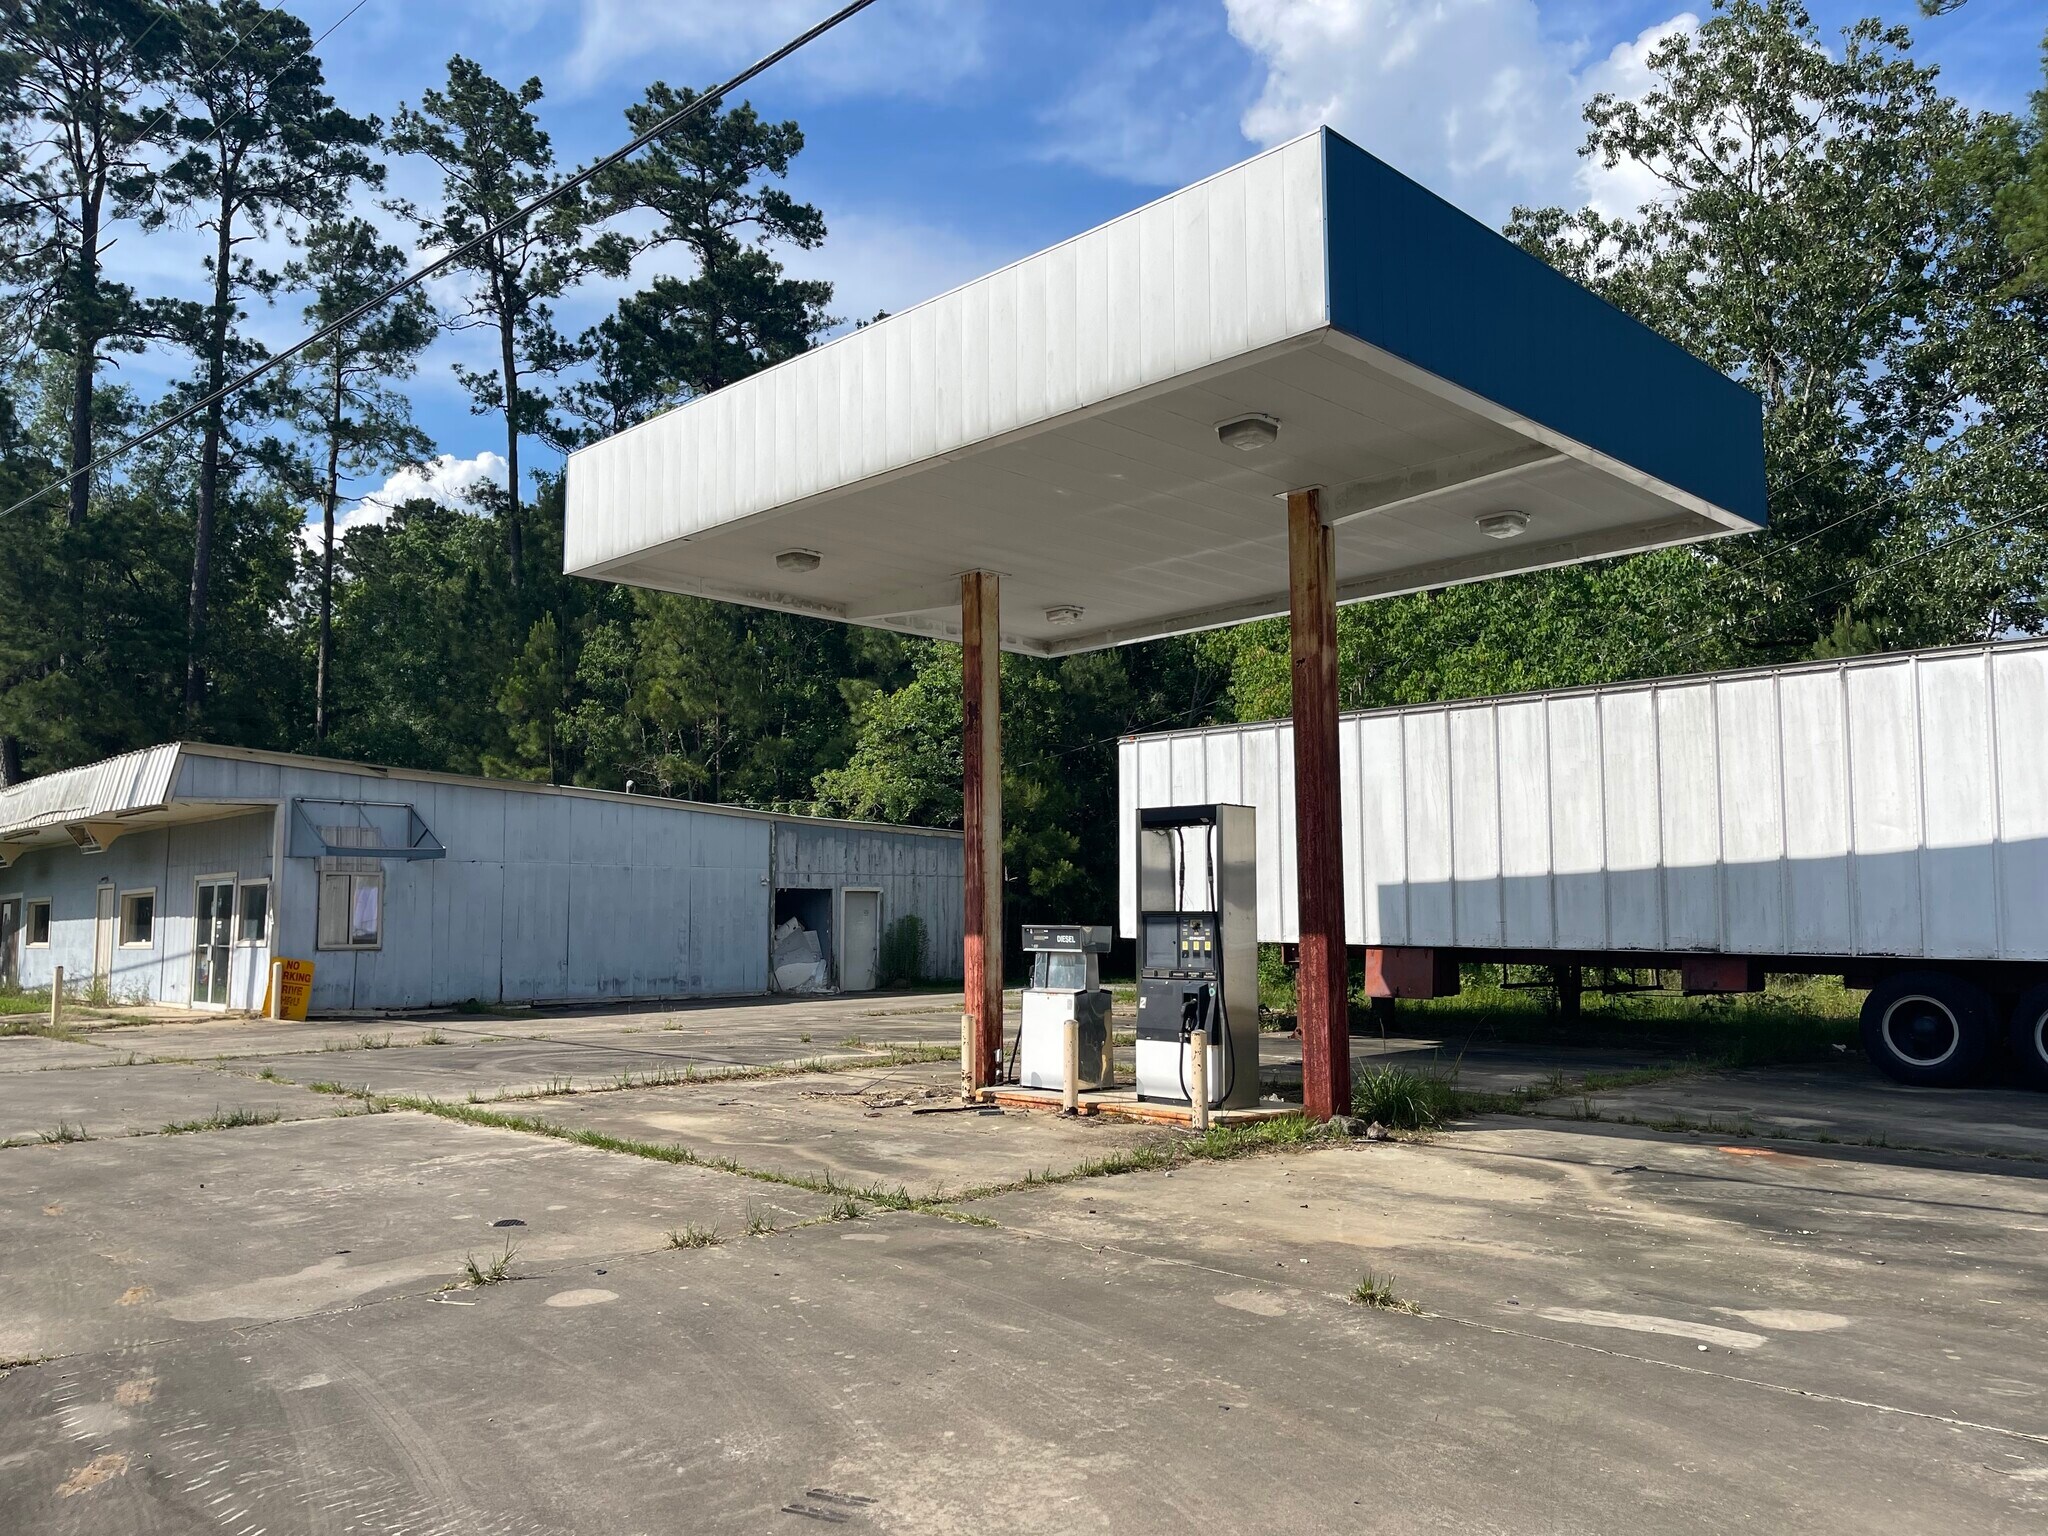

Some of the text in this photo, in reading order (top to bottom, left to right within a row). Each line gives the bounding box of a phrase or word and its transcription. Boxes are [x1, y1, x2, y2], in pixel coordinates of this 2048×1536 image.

[1056, 935, 1076, 943] DIESEL
[286, 960, 300, 970] NO
[282, 971, 311, 983] RKING
[281, 985, 304, 996] RIVE
